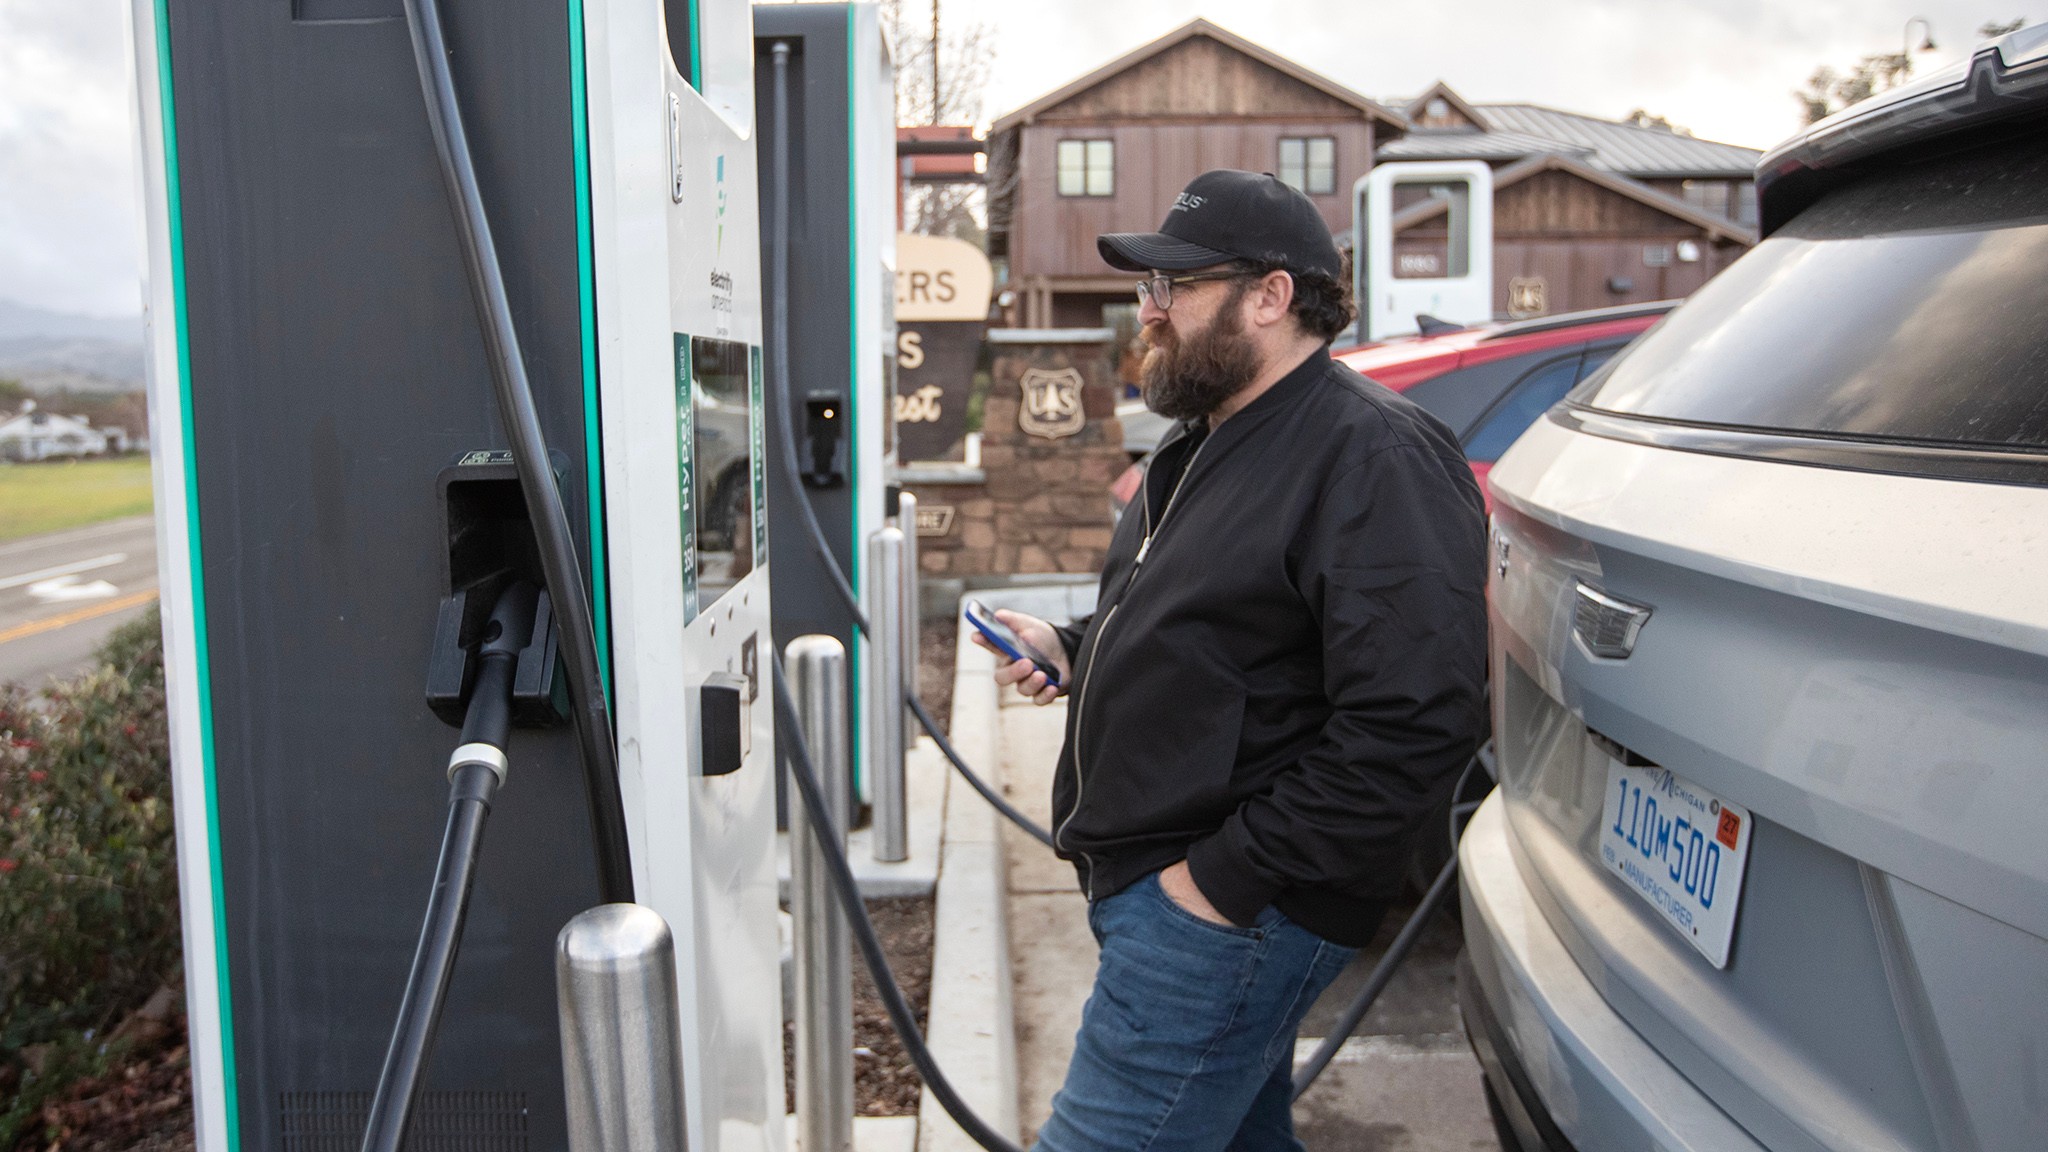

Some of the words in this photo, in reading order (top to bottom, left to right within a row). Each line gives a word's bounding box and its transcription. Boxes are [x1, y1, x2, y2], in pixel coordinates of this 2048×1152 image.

[899, 331, 925, 369] S
[1613, 778, 1720, 910] 110M500
[1723, 814, 1738, 835] 27
[1624, 859, 1693, 931] MANUFACTURER
